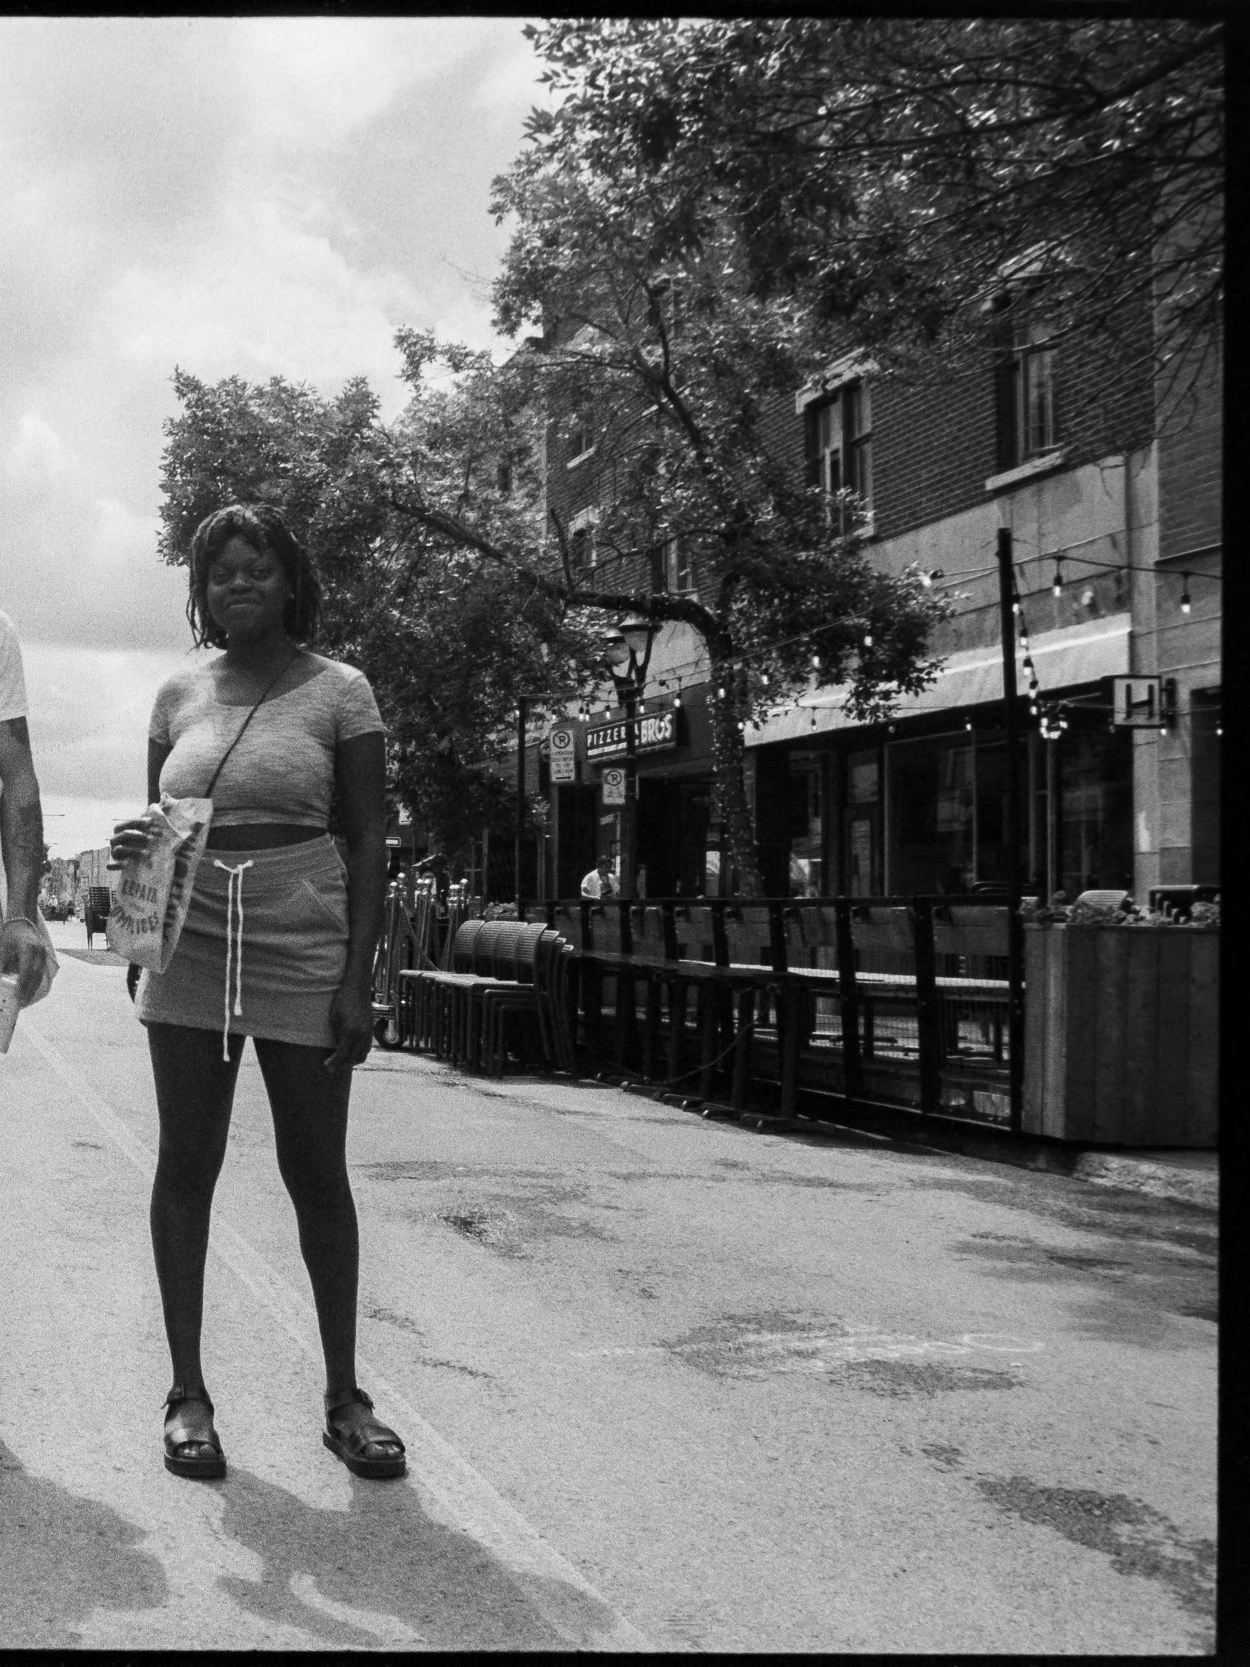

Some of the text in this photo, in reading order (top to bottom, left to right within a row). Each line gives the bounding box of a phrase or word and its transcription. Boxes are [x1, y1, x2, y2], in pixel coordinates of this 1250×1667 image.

[1125, 683, 1155, 720] H
[587, 723, 640, 748] PIZZER
[640, 713, 674, 745] BROS
